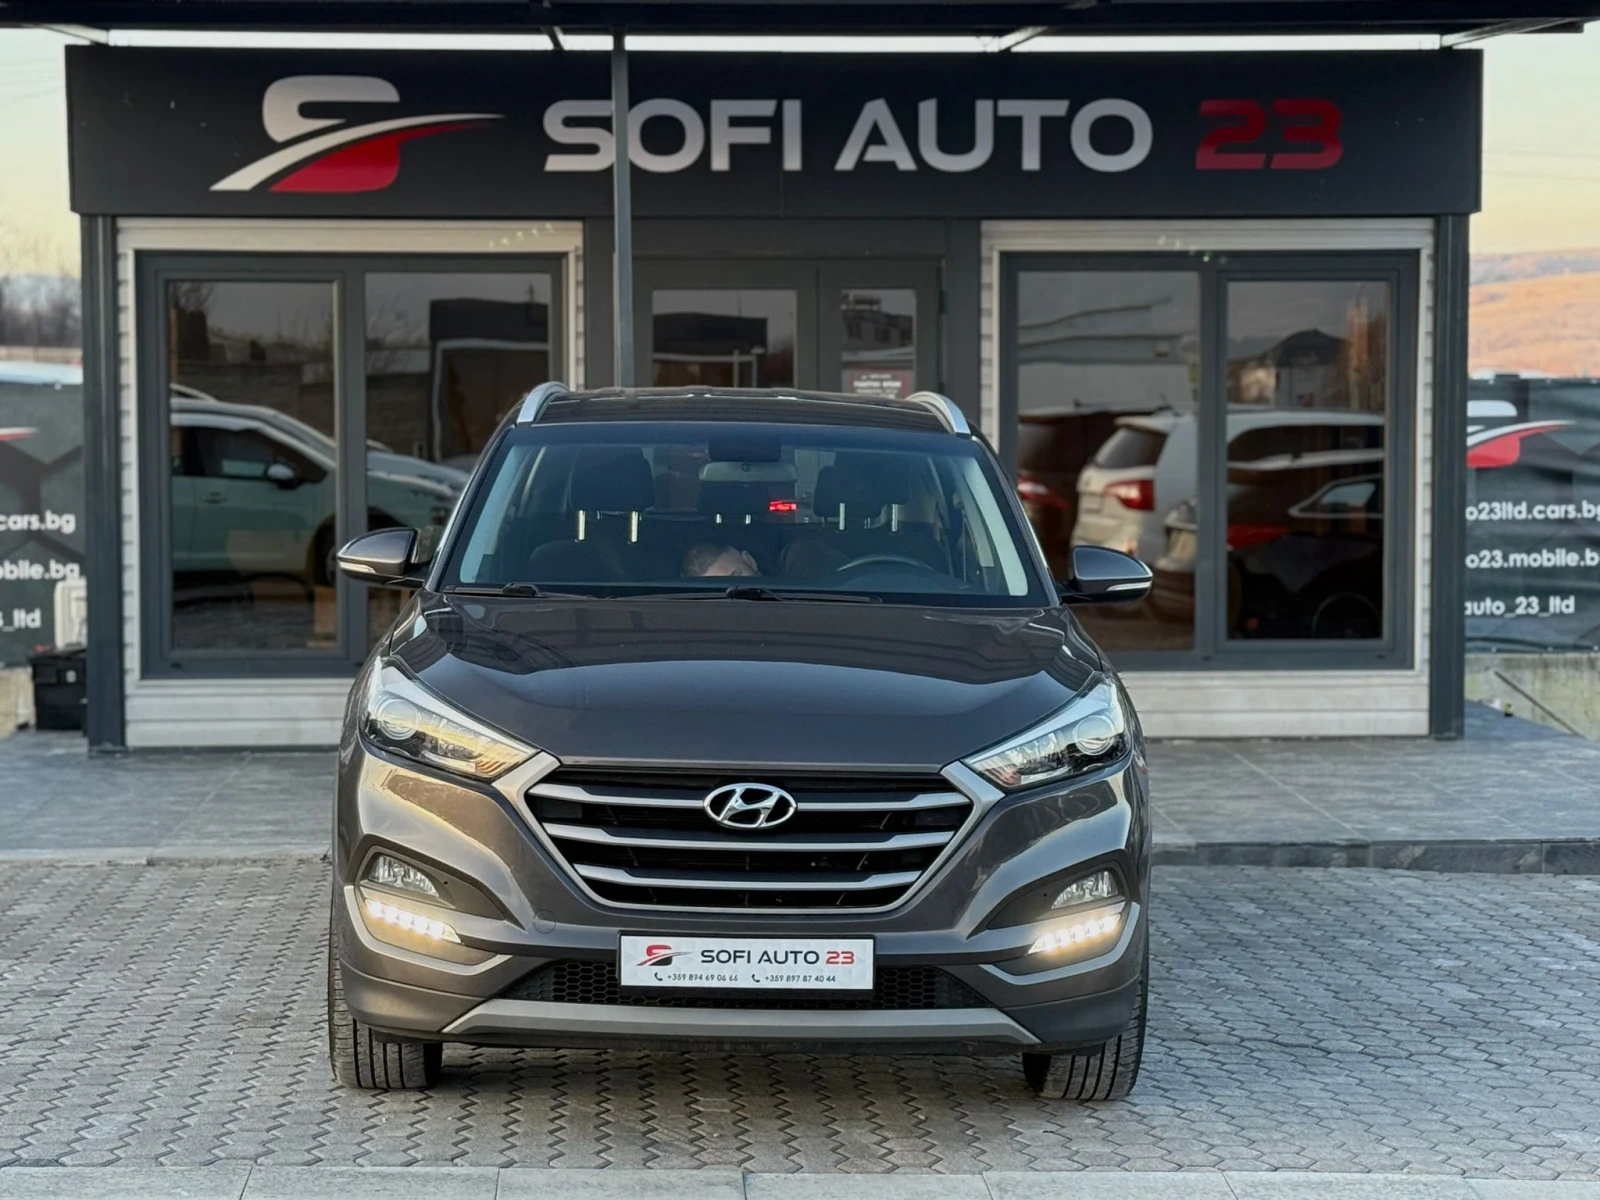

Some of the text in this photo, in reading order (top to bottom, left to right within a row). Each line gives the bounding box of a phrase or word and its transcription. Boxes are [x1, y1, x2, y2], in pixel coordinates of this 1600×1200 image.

[543, 98, 1342, 172] SOFI AUTO 23
[1465, 499, 1600, 522] o23ltd.cars.b
[0, 559, 80, 580] bile.bg
[0, 608, 42, 632] _ltd
[700, 949, 855, 965] SOFI AUTO 23
[667, 973, 687, 982] +359
[764, 974, 836, 983] +359 897 87 40 44
